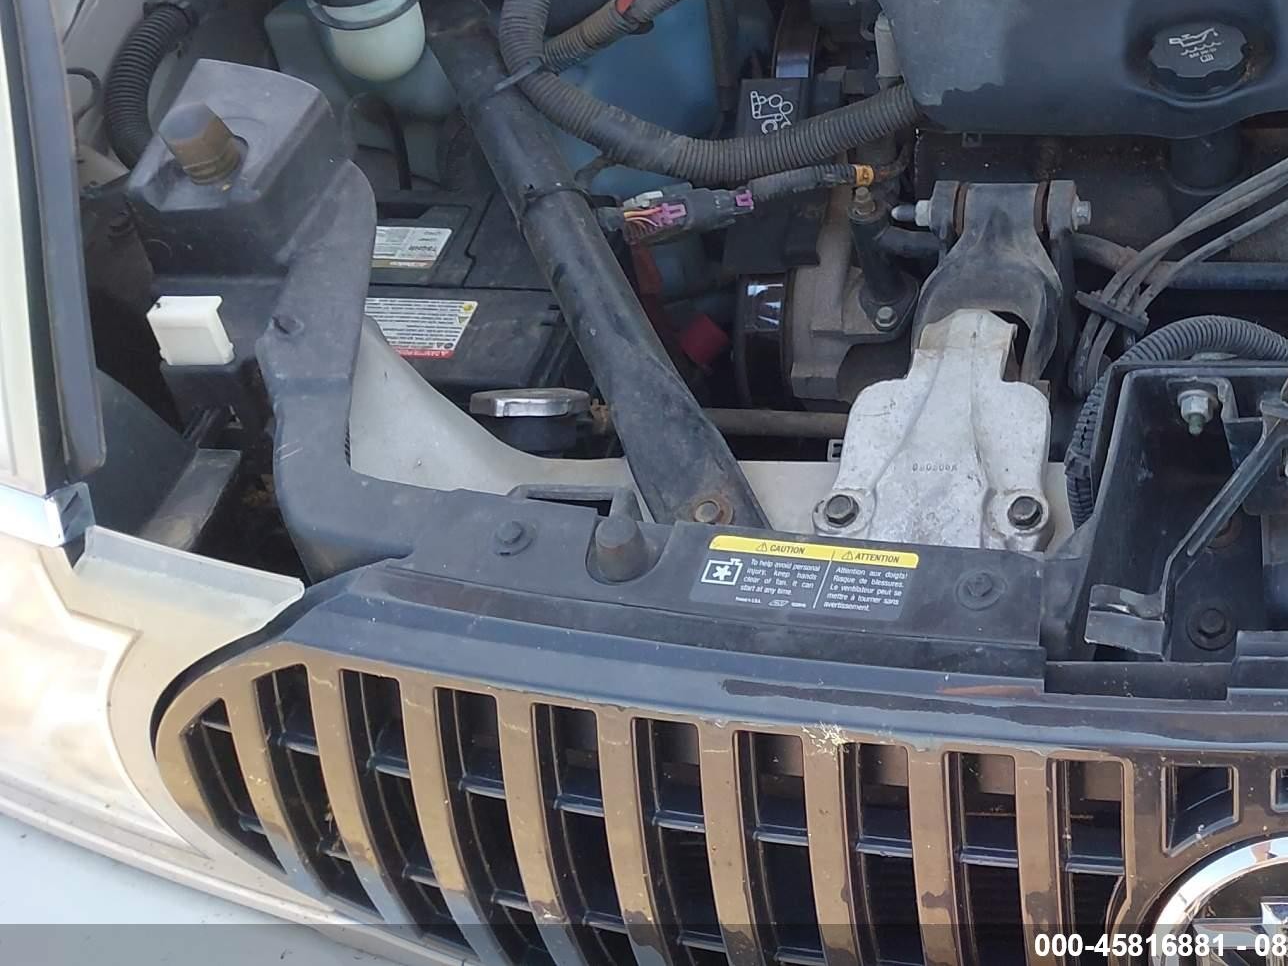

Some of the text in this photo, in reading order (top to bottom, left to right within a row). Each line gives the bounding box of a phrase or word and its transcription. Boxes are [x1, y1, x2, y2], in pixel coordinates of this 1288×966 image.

[770, 544, 806, 554] CAUTION
[855, 553, 900, 563] ATTENTION
[751, 558, 820, 571] To help avoid personal
[774, 570, 790, 578] keep
[797, 572, 817, 580] hands
[836, 566, 866, 576] Attention
[885, 571, 908, 580] doigts!
[833, 575, 855, 583] Risque
[871, 579, 904, 587] blessures.
[841, 585, 875, 594] ventilateur
[858, 595, 882, 603] tourner
